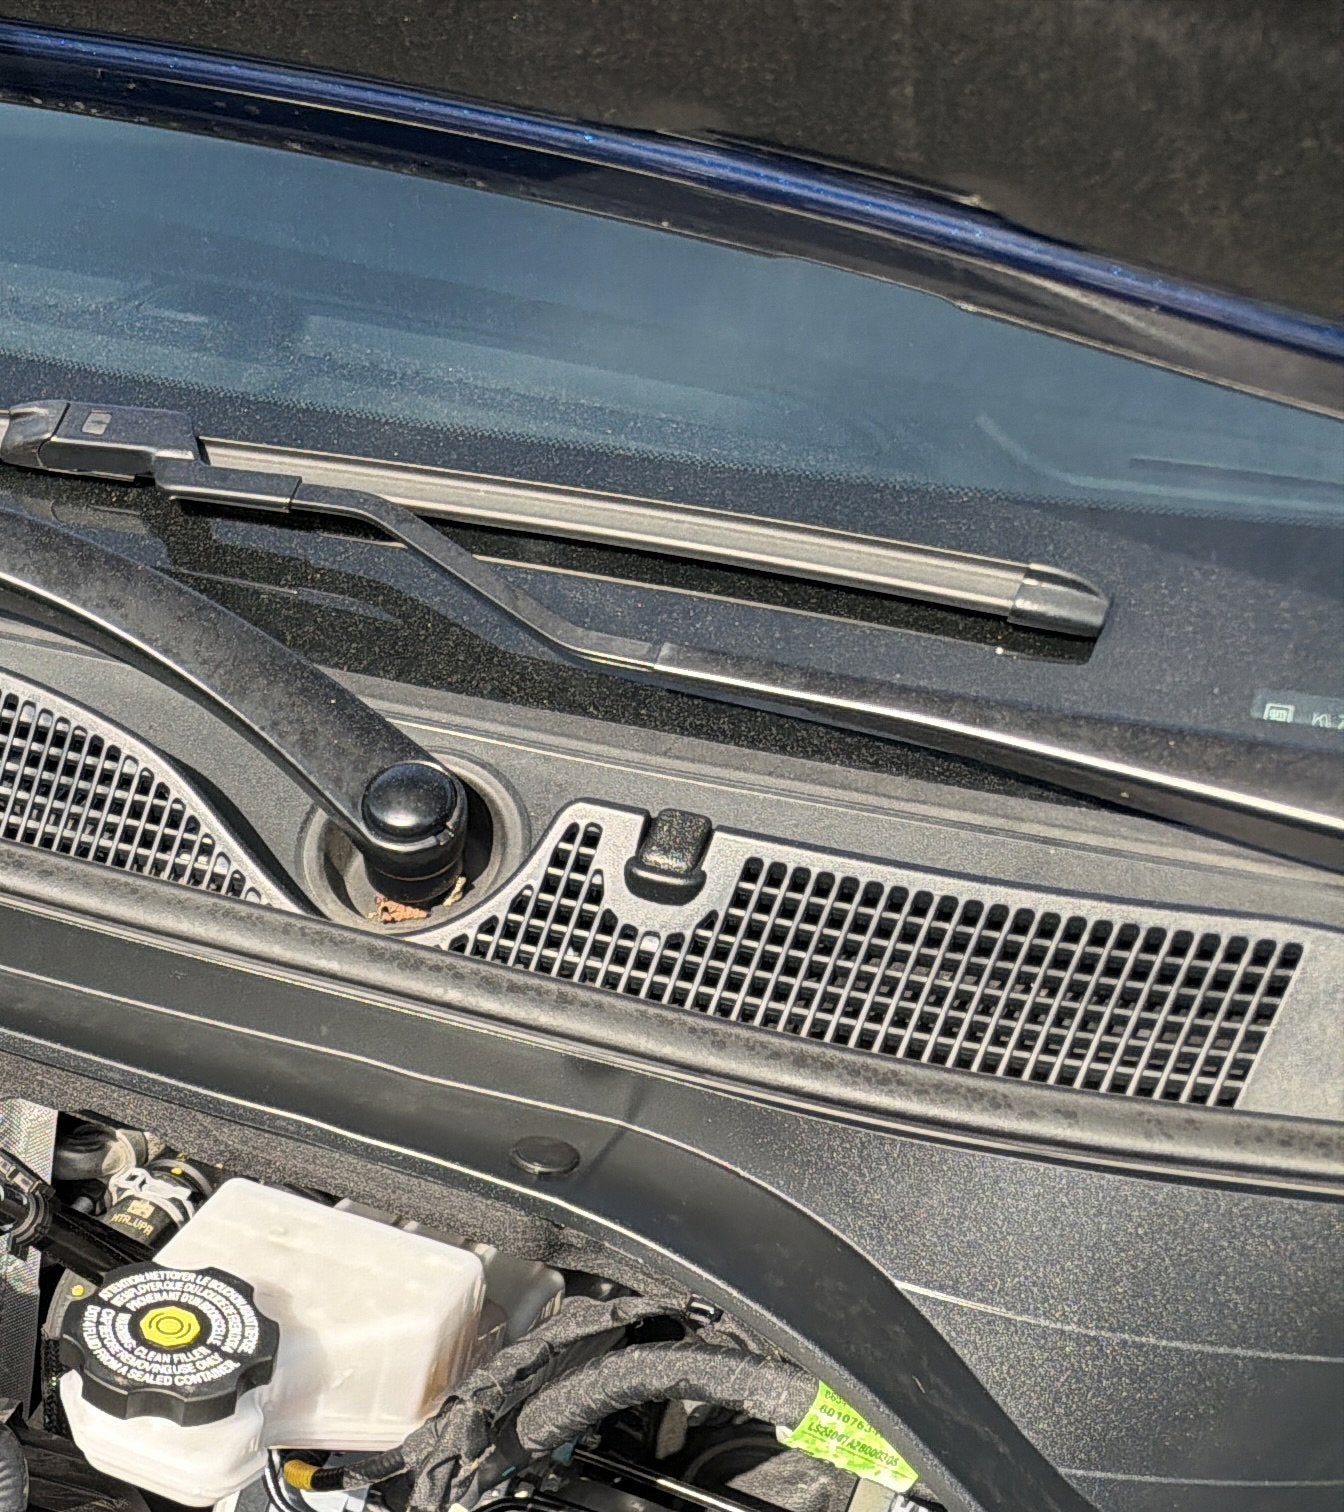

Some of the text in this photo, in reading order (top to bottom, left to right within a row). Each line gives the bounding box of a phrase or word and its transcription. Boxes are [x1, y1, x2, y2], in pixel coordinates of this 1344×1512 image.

[134, 1346, 171, 1363] CLEAN
[173, 1346, 212, 1363] FILLER
[127, 1368, 172, 1385] SEALED
